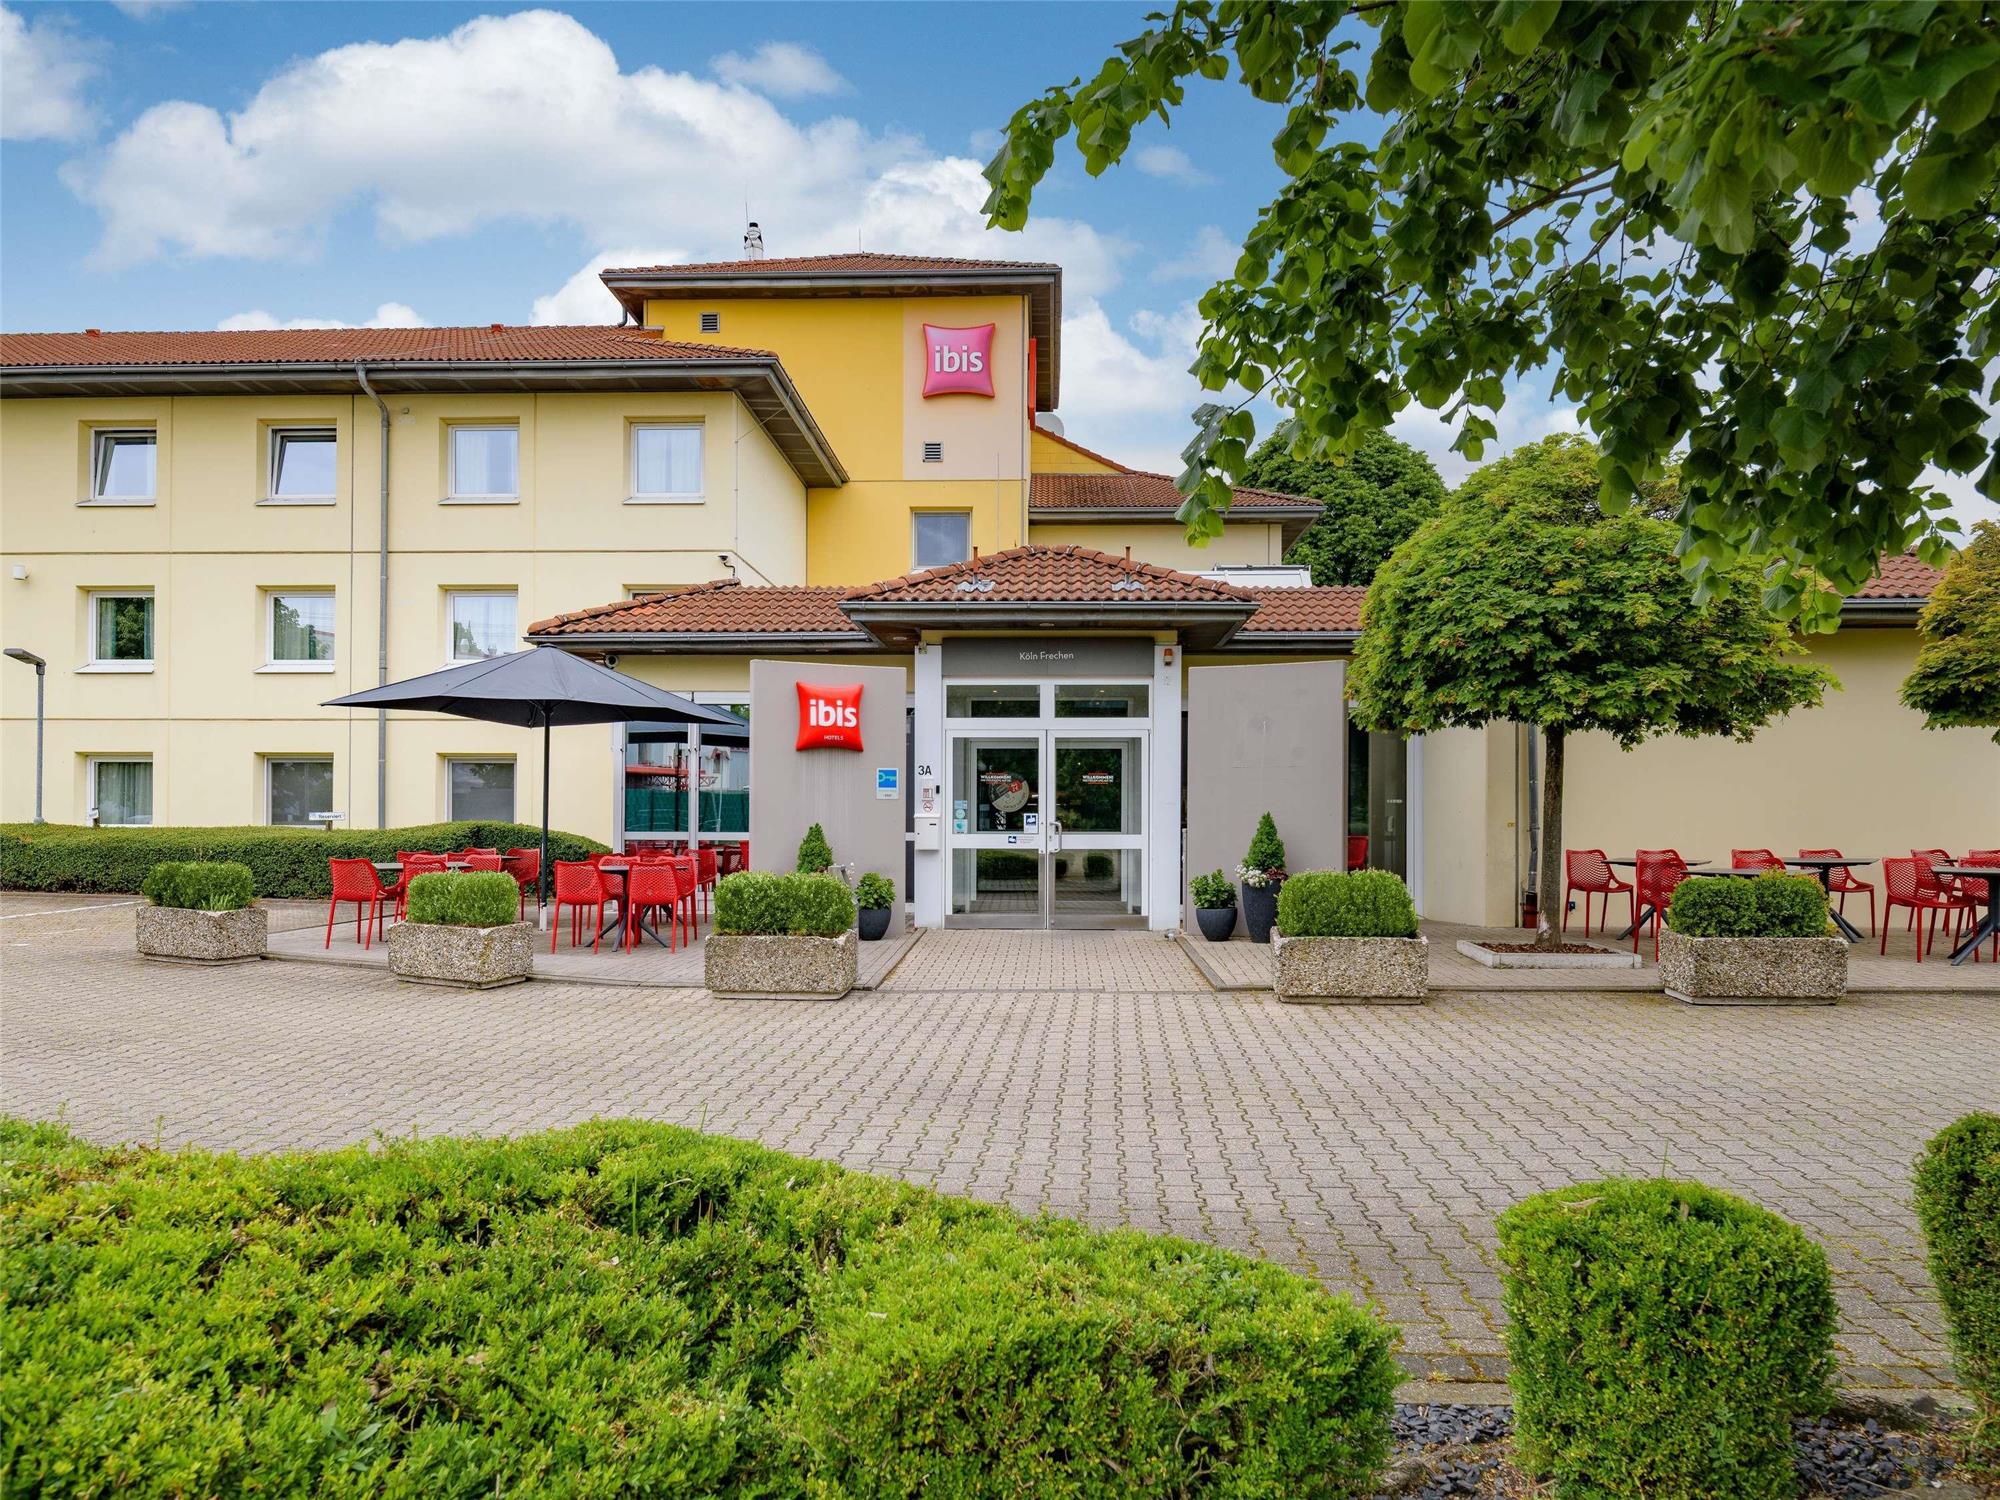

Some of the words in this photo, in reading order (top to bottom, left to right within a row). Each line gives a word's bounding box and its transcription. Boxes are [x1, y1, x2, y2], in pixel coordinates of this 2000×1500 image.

[935, 345, 983, 372] ibis
[1019, 651, 1038, 661] Köln
[1040, 650, 1074, 661] Frechen
[810, 699, 857, 727] ibis
[918, 765, 932, 776] 3A
